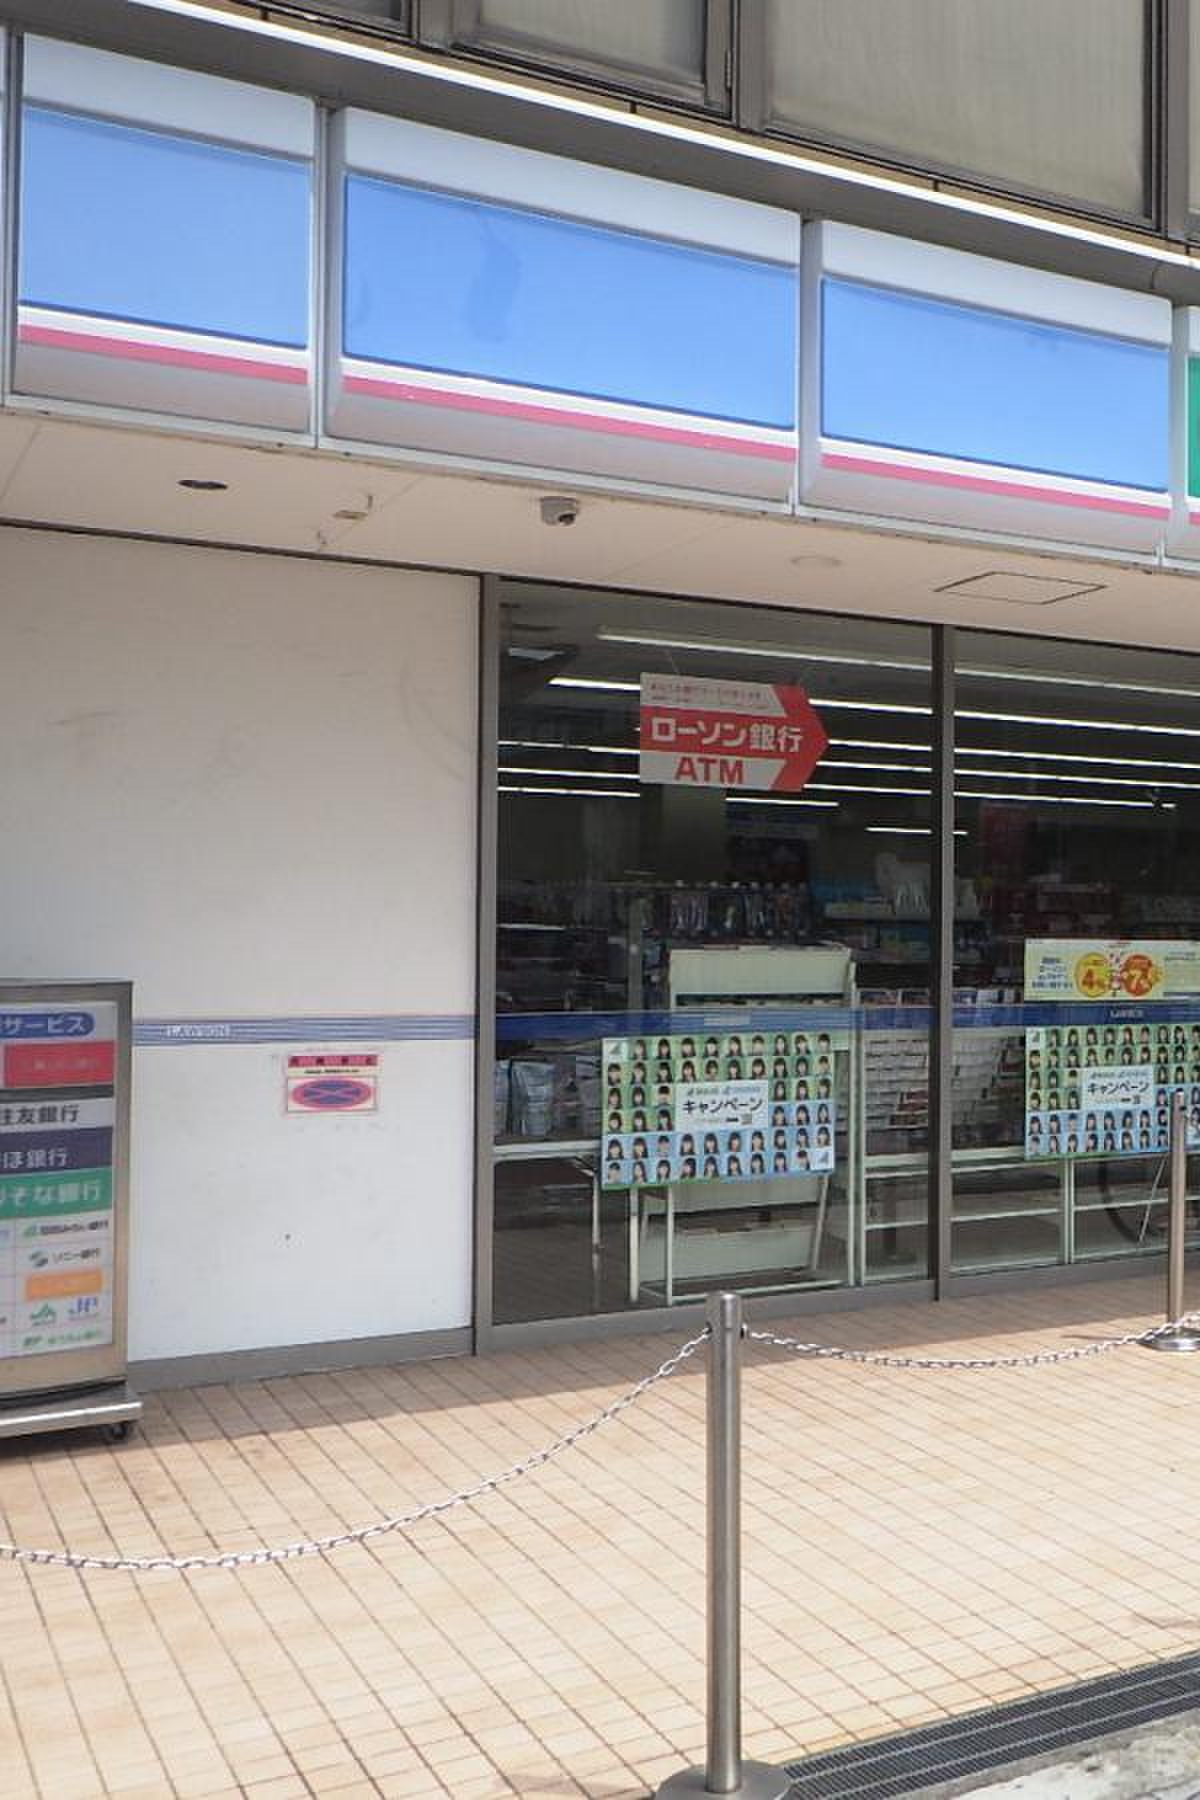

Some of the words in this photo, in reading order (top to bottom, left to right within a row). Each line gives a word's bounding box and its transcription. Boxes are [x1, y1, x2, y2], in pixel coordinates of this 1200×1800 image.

[652, 717, 803, 752] ローソン銀行
[675, 757, 744, 784] ATM
[2, 1015, 86, 1036] サービス
[1088, 1080, 1149, 1095] キャンペーン
[682, 1098, 763, 1114] キャンペーン
